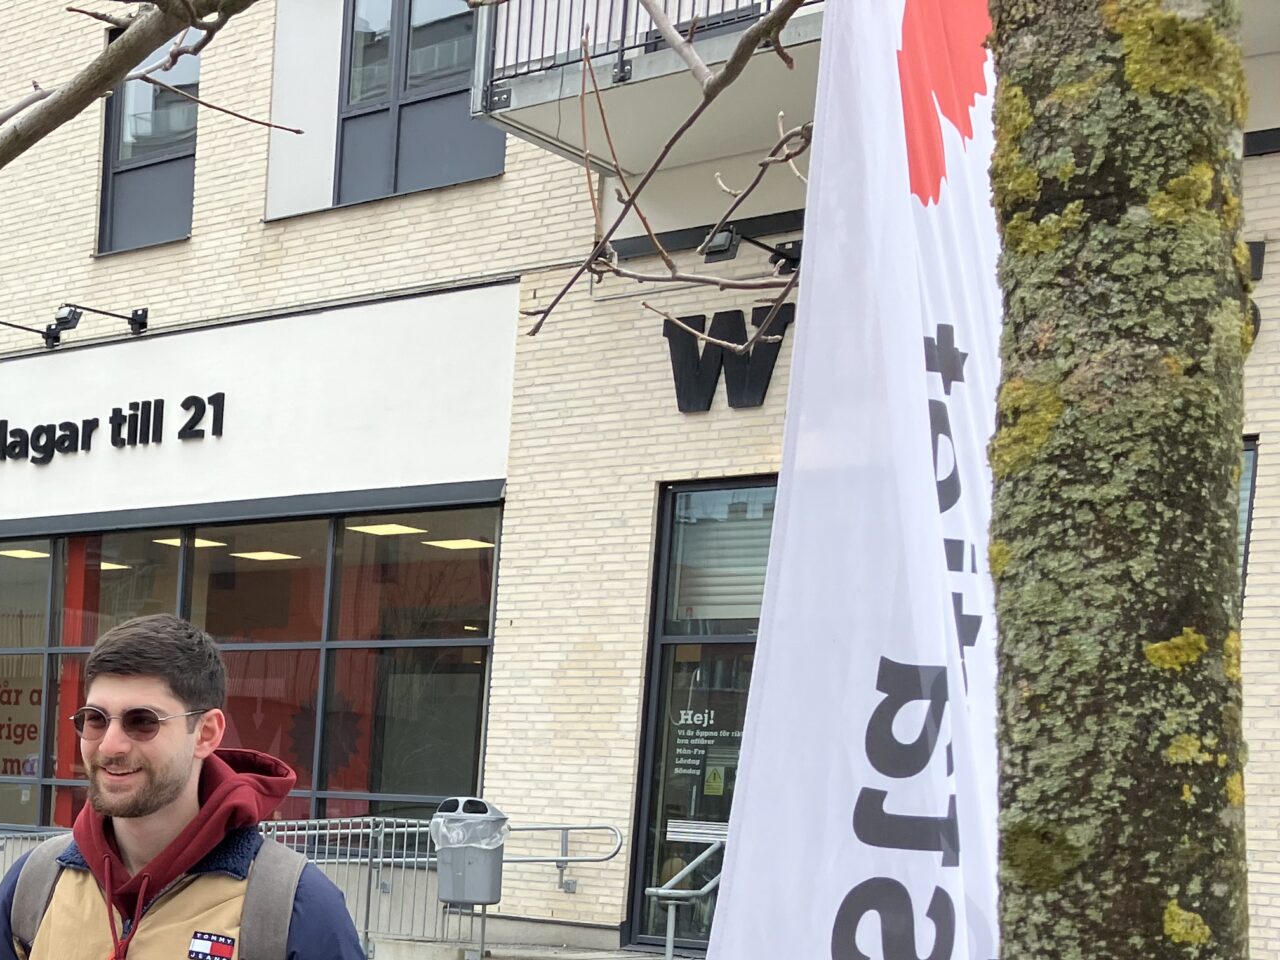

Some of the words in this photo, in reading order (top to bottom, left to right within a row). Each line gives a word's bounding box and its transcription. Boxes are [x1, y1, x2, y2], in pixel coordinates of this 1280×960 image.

[109, 398, 165, 449] till
[177, 391, 226, 440] 21
[679, 709, 715, 727] Hej!
[195, 931, 233, 945] TOMMY
